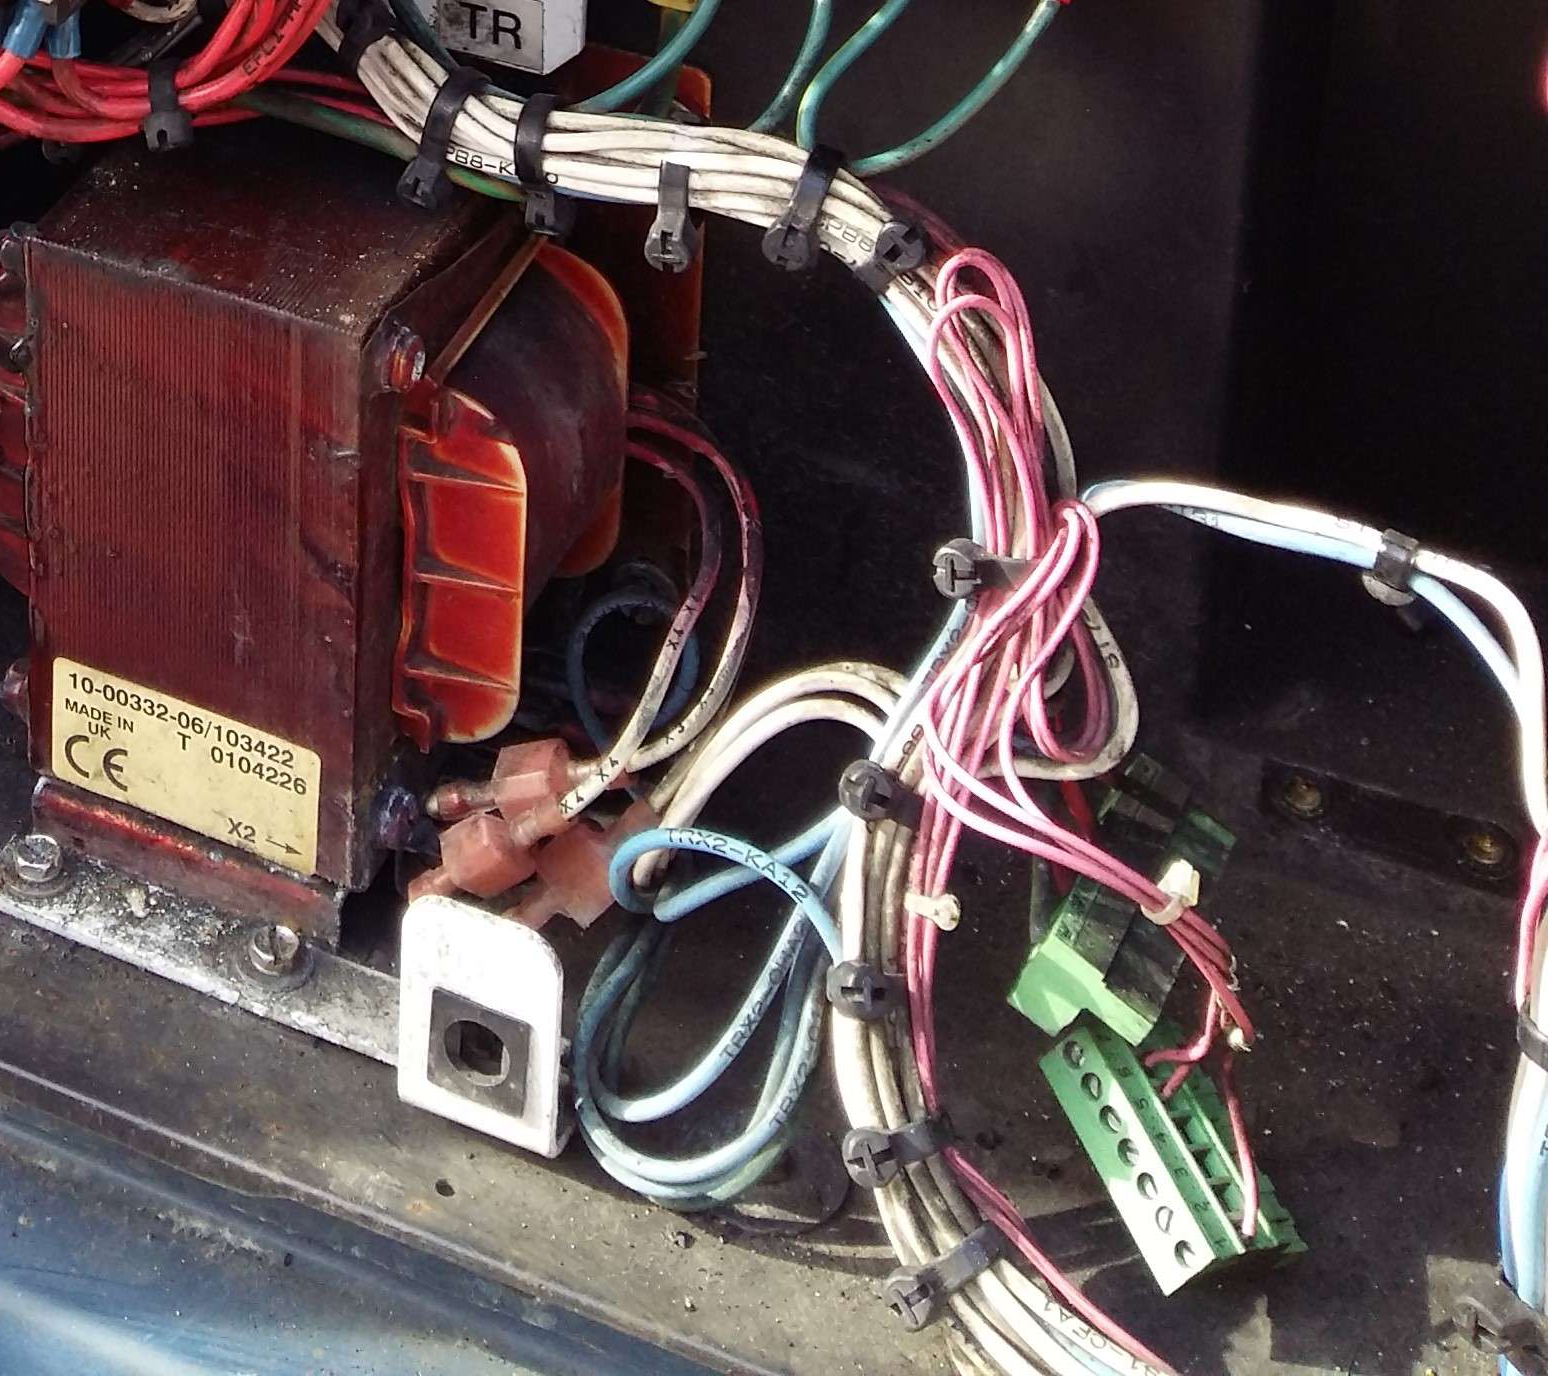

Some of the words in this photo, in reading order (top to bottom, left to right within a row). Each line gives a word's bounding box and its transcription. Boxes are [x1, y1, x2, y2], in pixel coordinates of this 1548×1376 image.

[460, 1, 522, 50] TR
[64, 697, 113, 726] MADE
[117, 716, 134, 733] IN
[68, 672, 294, 769] 10-00332-06/103422
[88, 721, 112, 740] UK
[176, 731, 191, 751] T
[210, 745, 308, 796] 0104226
[227, 816, 256, 844] X2
[666, 827, 812, 904] TRX2-KA12
